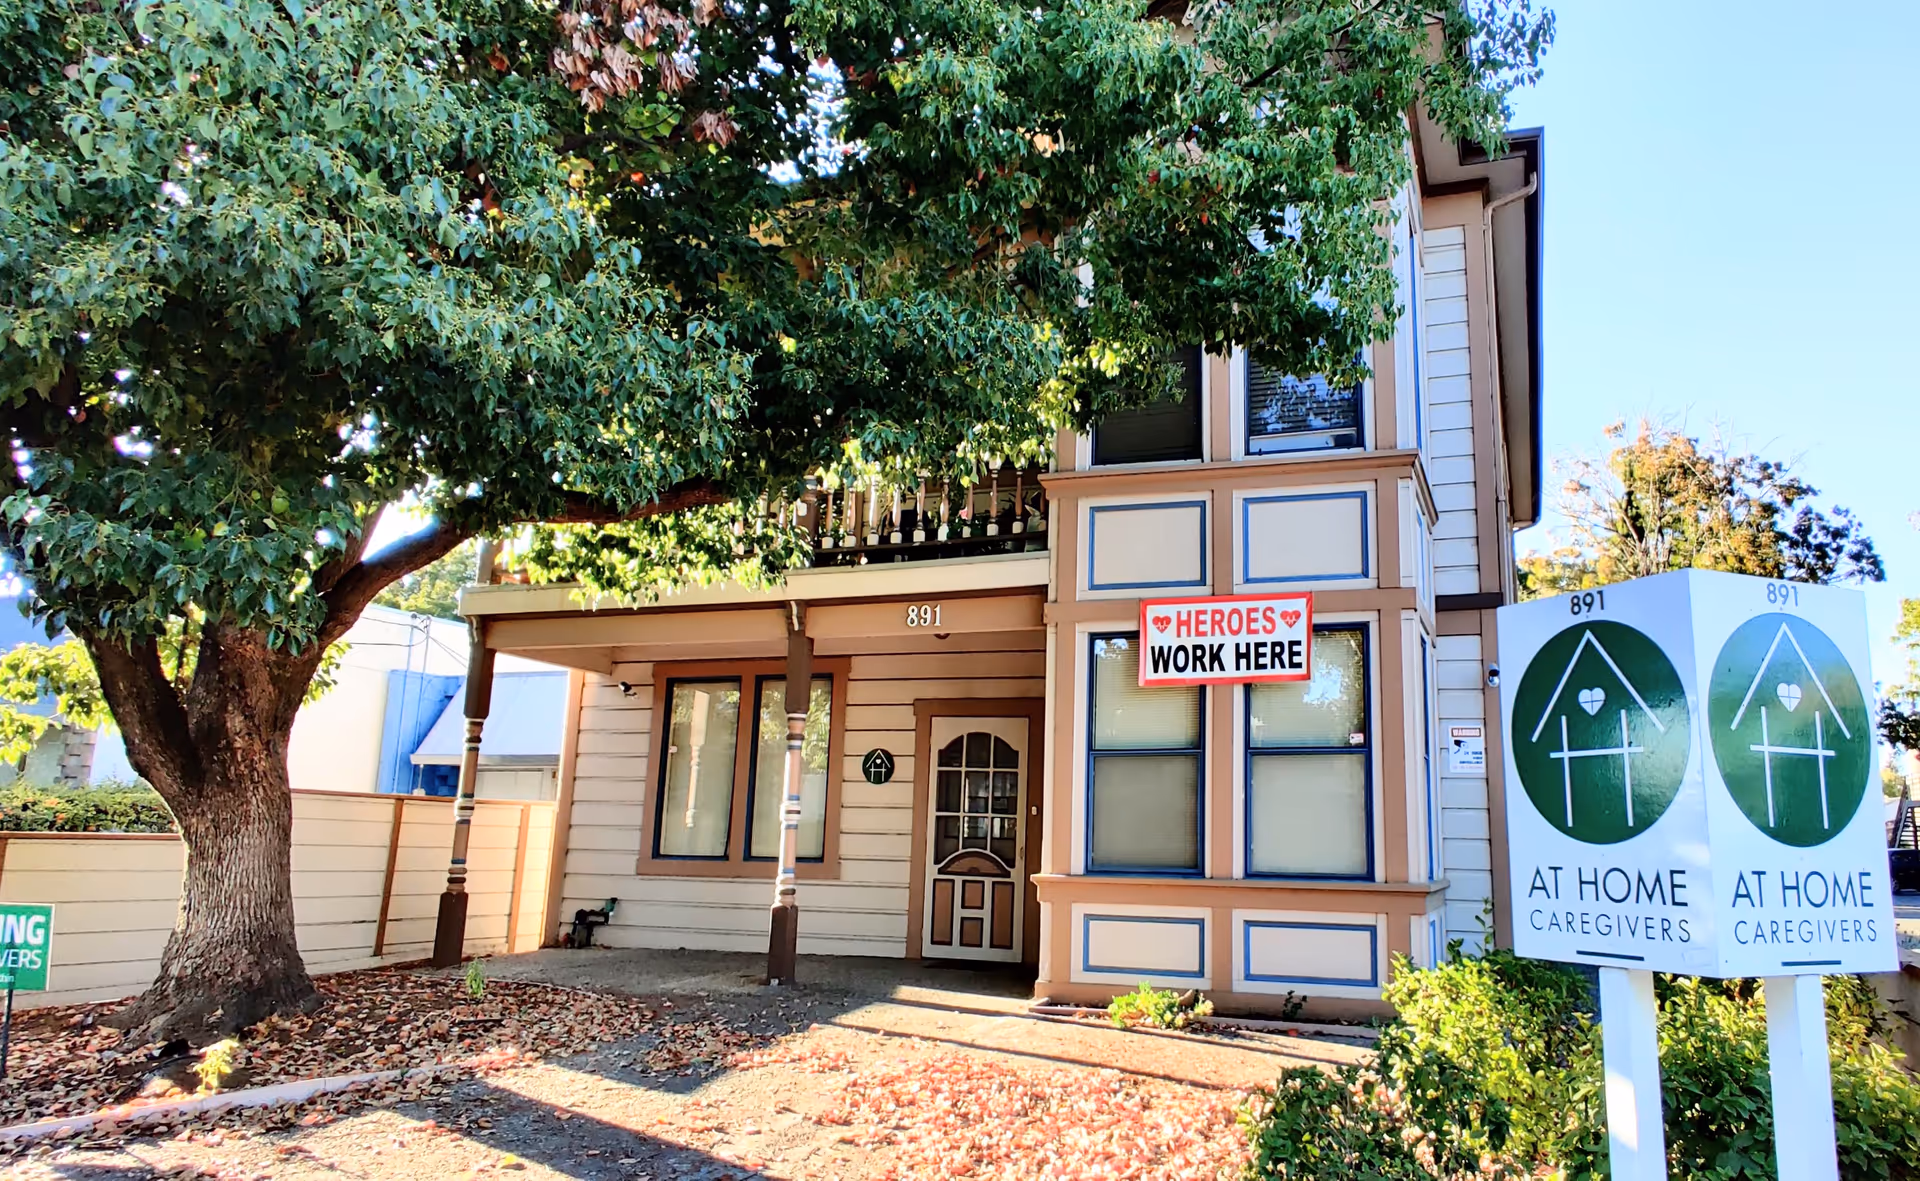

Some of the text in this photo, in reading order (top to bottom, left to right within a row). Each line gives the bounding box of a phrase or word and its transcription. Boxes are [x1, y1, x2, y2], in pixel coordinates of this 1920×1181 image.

[1570, 590, 1605, 616] 891
[1766, 582, 1799, 607] 891
[906, 604, 941, 627] 891
[1176, 606, 1277, 638] HEROES
[1150, 640, 1303, 674] WORK HERE
[1528, 865, 1689, 907] AT HOME
[1732, 870, 1874, 908] AT HOME
[1530, 909, 1691, 943] CAREGIVERS
[1734, 919, 1878, 945] CAREGIVERS
